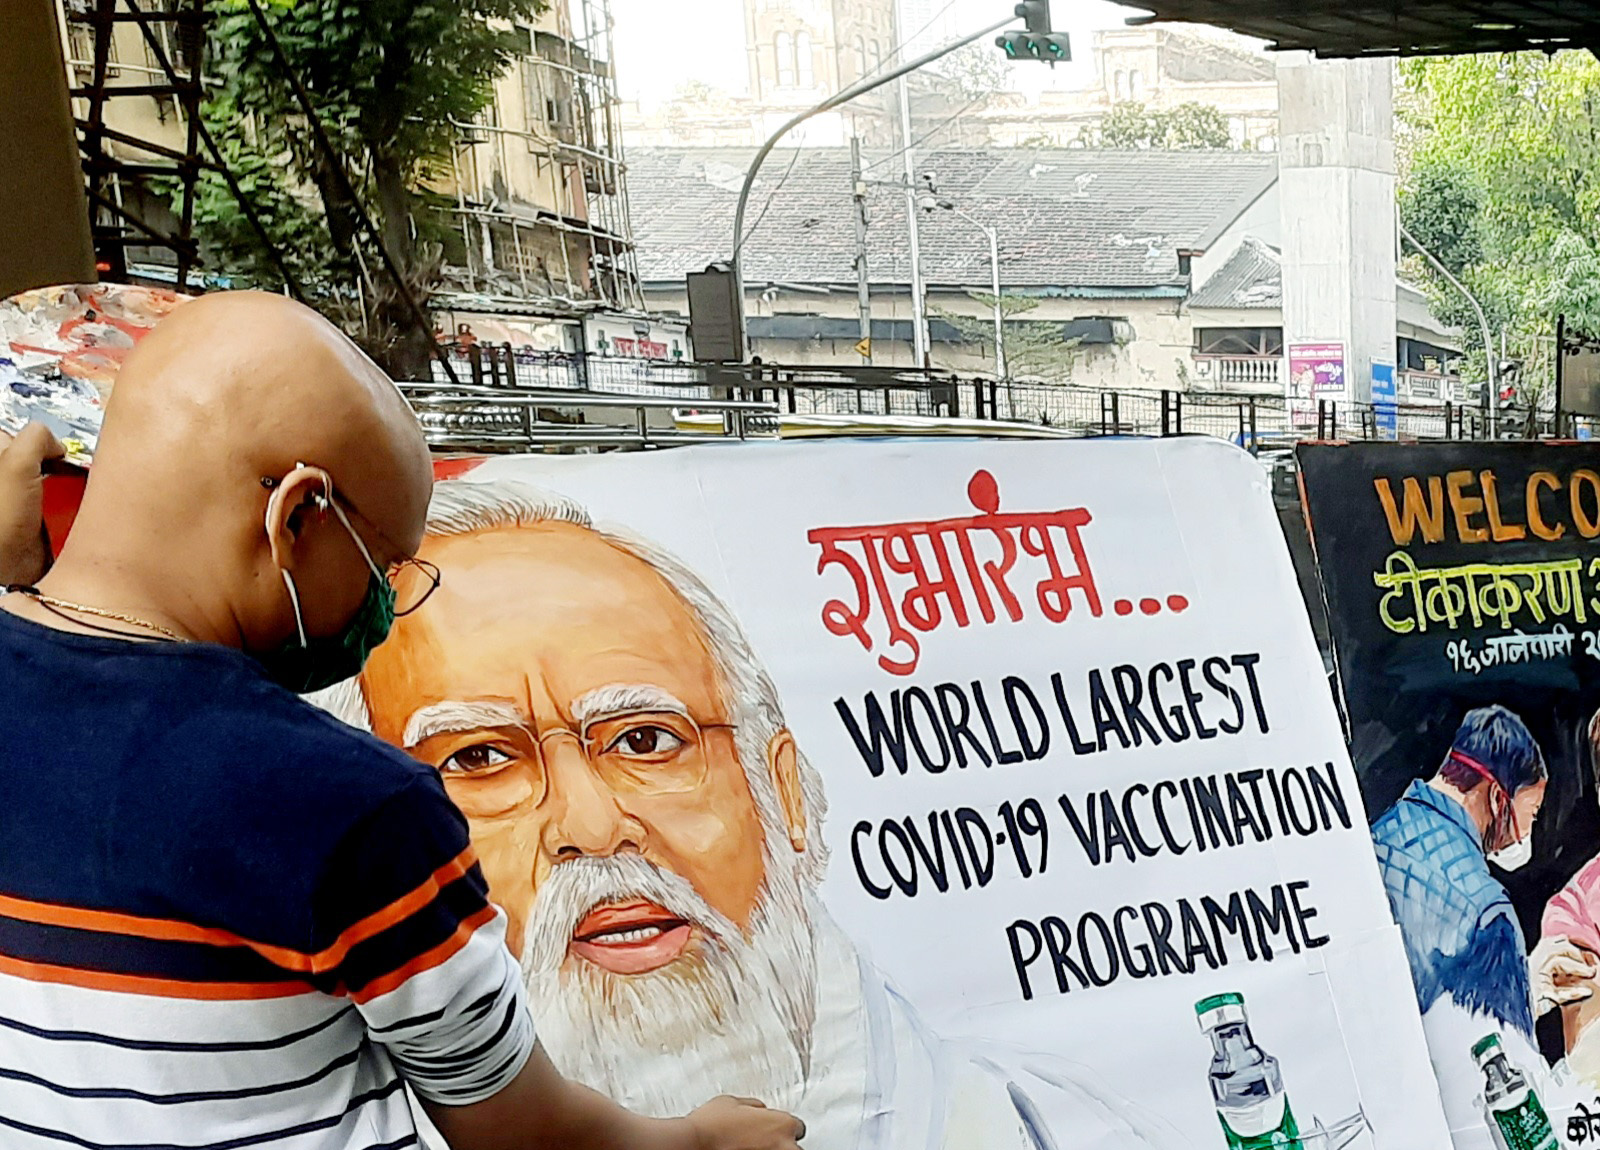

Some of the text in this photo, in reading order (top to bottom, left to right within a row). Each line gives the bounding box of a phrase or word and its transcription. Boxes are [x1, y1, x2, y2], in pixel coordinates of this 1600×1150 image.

[1374, 551, 1587, 633] टीकाकरण
[834, 654, 1269, 778] WORLD LARGEST
[851, 762, 1352, 898] COVID-19 VACCINATION
[1006, 881, 1329, 999] PROGRAMME
